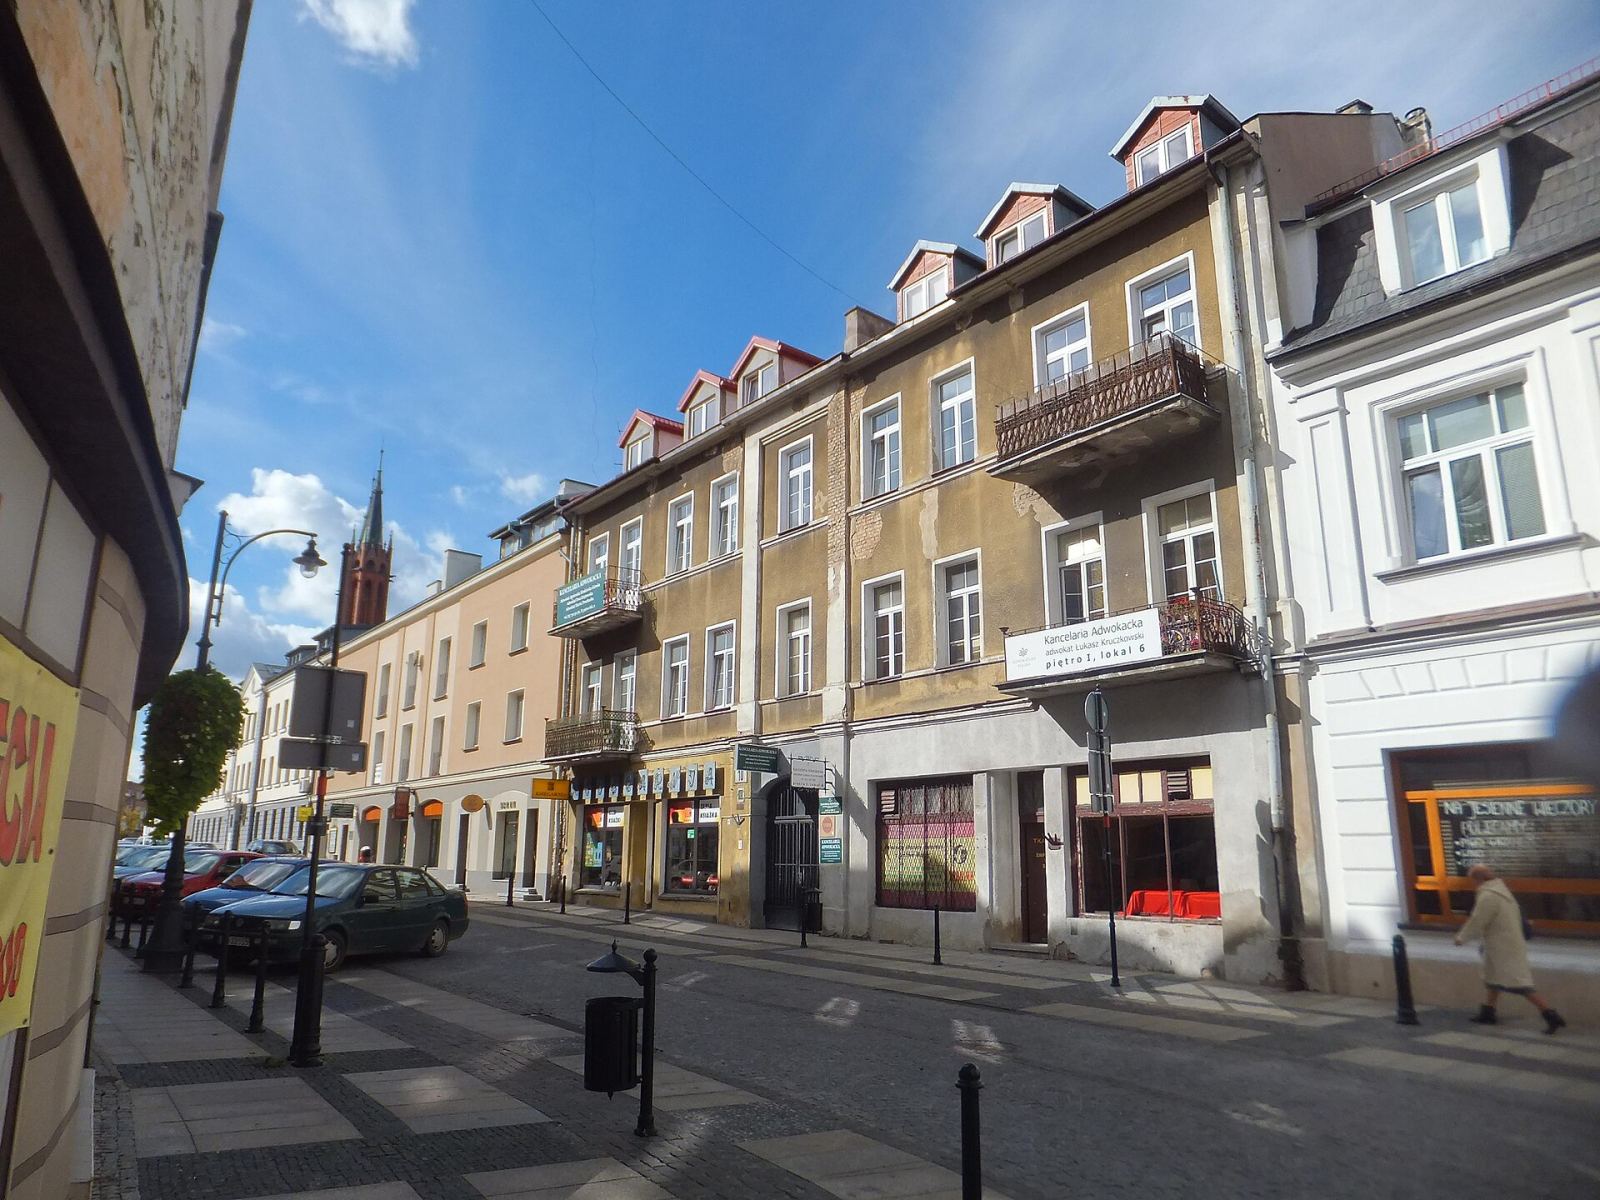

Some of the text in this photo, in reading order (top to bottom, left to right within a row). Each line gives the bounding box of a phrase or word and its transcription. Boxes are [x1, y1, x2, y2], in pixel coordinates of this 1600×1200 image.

[1044, 619, 1143, 645] Kancelaria Adwokacka
[1045, 644, 1074, 656] adwokat
[1046, 656, 1083, 669] piętro
[1100, 645, 1132, 660] lokal
[1139, 643, 1146, 653] 6
[1443, 801, 1463, 815] NA
